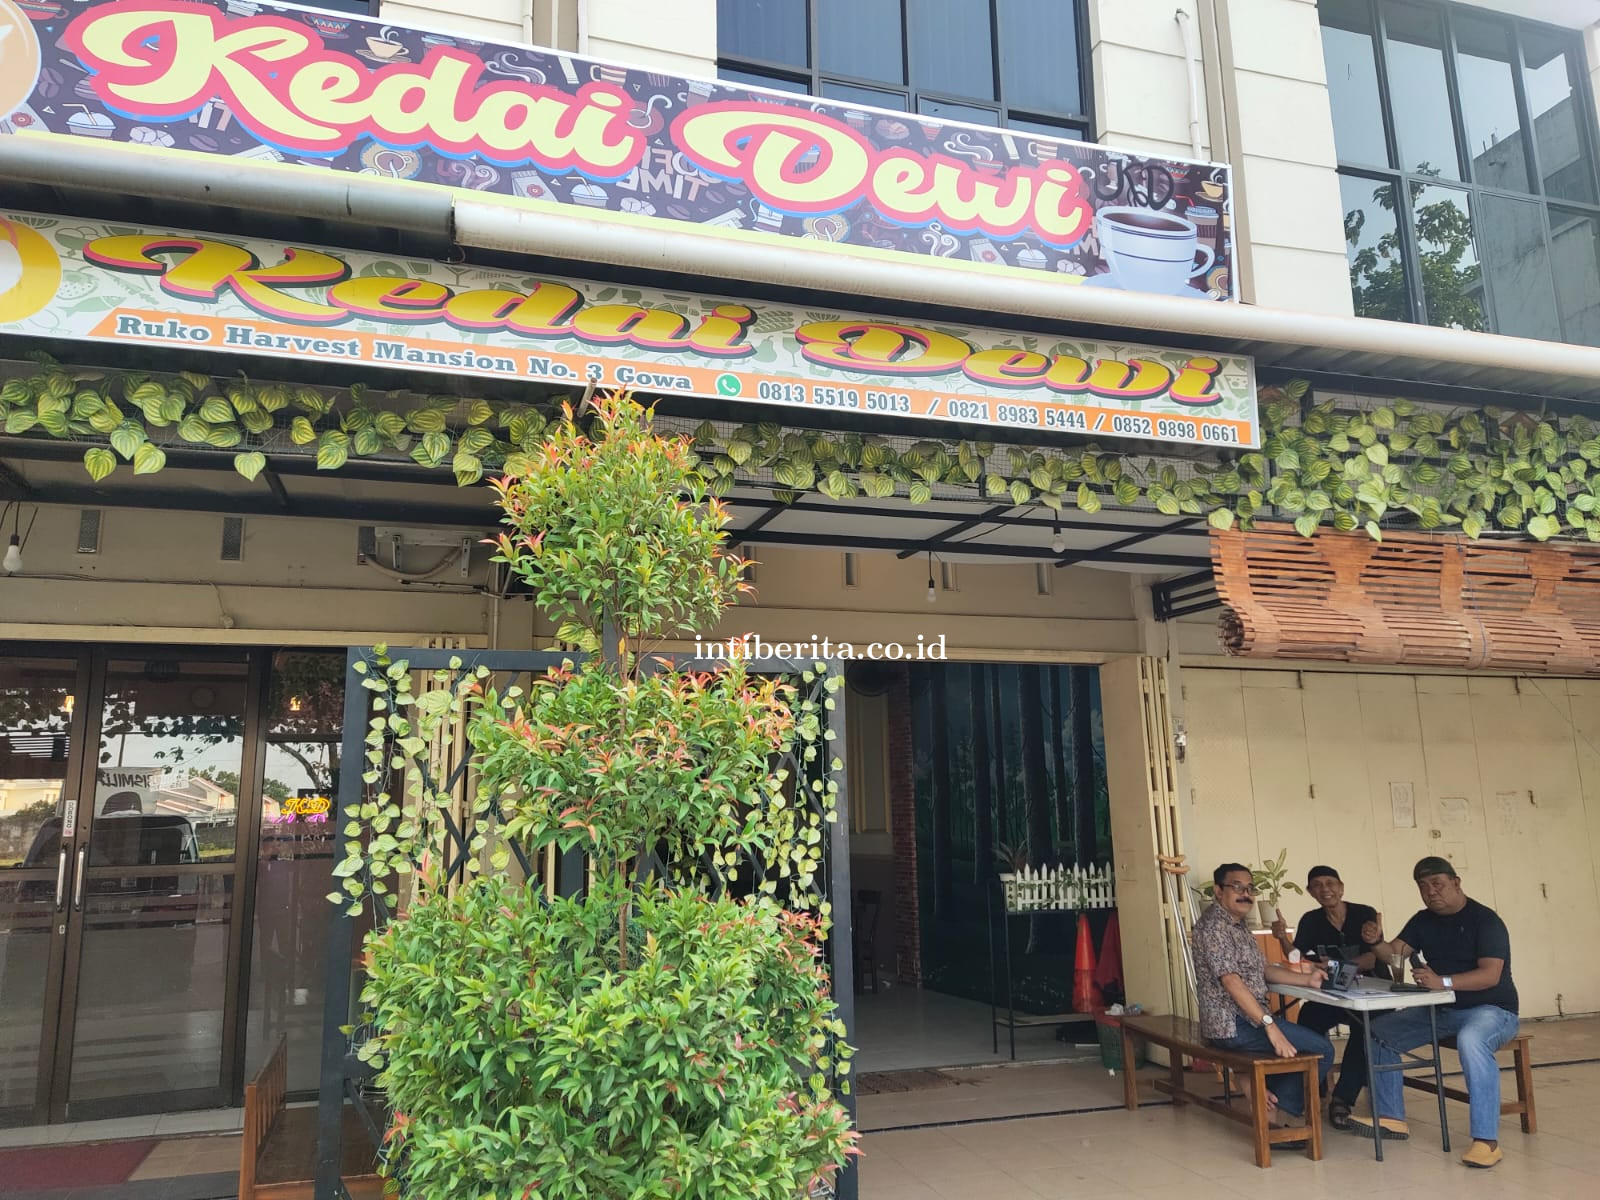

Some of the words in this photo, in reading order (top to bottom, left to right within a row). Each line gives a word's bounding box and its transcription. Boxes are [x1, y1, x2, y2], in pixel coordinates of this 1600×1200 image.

[80, 9, 635, 168] Kedai
[681, 109, 1083, 236] Dewi
[83, 235, 757, 360] Kedai
[794, 320, 1223, 406] Dewi
[117, 315, 210, 341] Ruko
[226, 326, 361, 356] Harvest
[374, 341, 515, 372] Mansion
[529, 358, 577, 379] No.
[587, 363, 602, 381] 3
[616, 366, 692, 389] Gowa
[759, 382, 805, 402] 0813
[814, 387, 858, 408] 5519
[867, 392, 910, 412] 5013
[927, 398, 940, 415] /
[949, 400, 989, 419] 0821
[998, 404, 1039, 424] 8983
[1046, 409, 1086, 428] 5444
[1095, 414, 1105, 430] /
[1113, 416, 1151, 434] 0852
[1158, 420, 1195, 439] 9898
[1202, 425, 1238, 442] 0661
